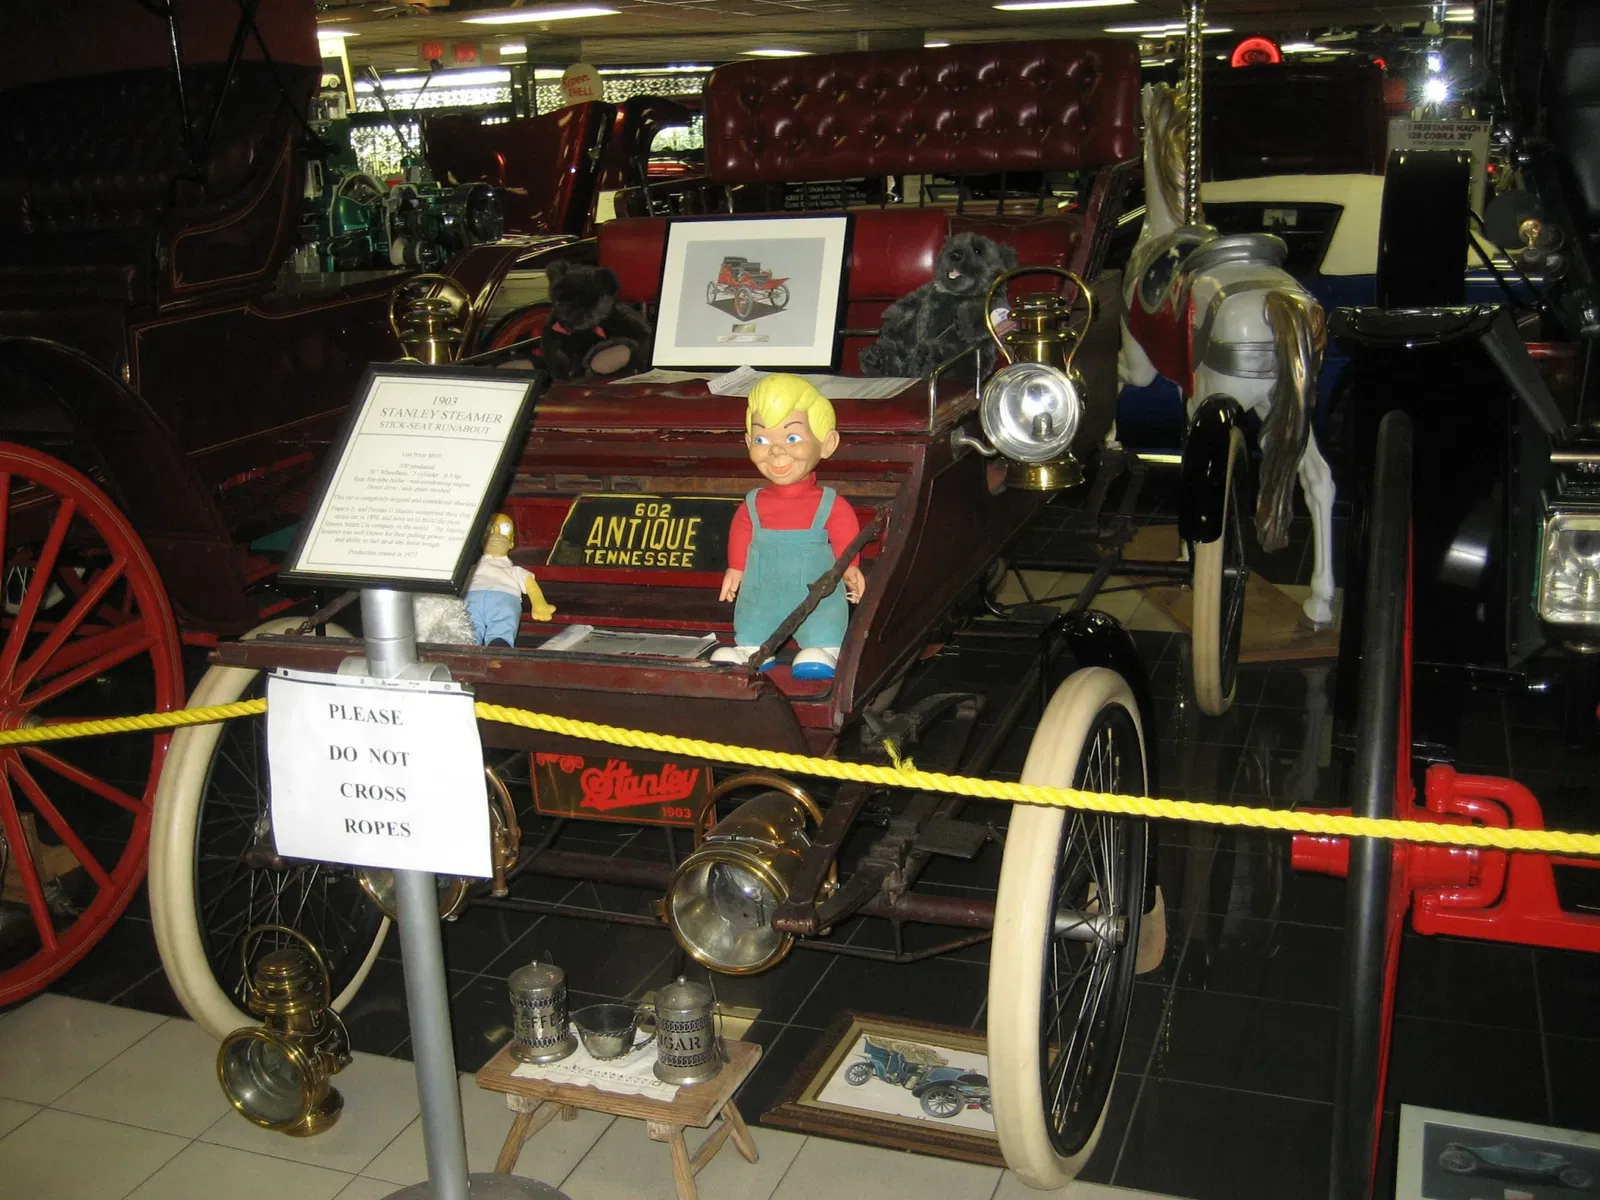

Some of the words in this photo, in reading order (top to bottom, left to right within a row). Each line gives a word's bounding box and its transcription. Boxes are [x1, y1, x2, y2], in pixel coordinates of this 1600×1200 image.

[1423, 132, 1454, 140] COBRA
[432, 396, 458, 406] 1903
[380, 407, 438, 420] STANLEY
[440, 410, 503, 424] STEAMER
[379, 421, 432, 431] STICK-SEAT
[435, 423, 491, 434] RUNABOUT
[635, 503, 672, 518] 602
[586, 516, 702, 551] ANTIQUE
[584, 549, 695, 568] TENNESSEE
[328, 703, 404, 726] PLEASE
[328, 744, 358, 763] DO
[369, 747, 410, 767] NOT
[339, 782, 407, 803] CROSS
[580, 758, 700, 812] Stanley
[661, 807, 692, 819] 1903
[344, 818, 411, 838] ROPES
